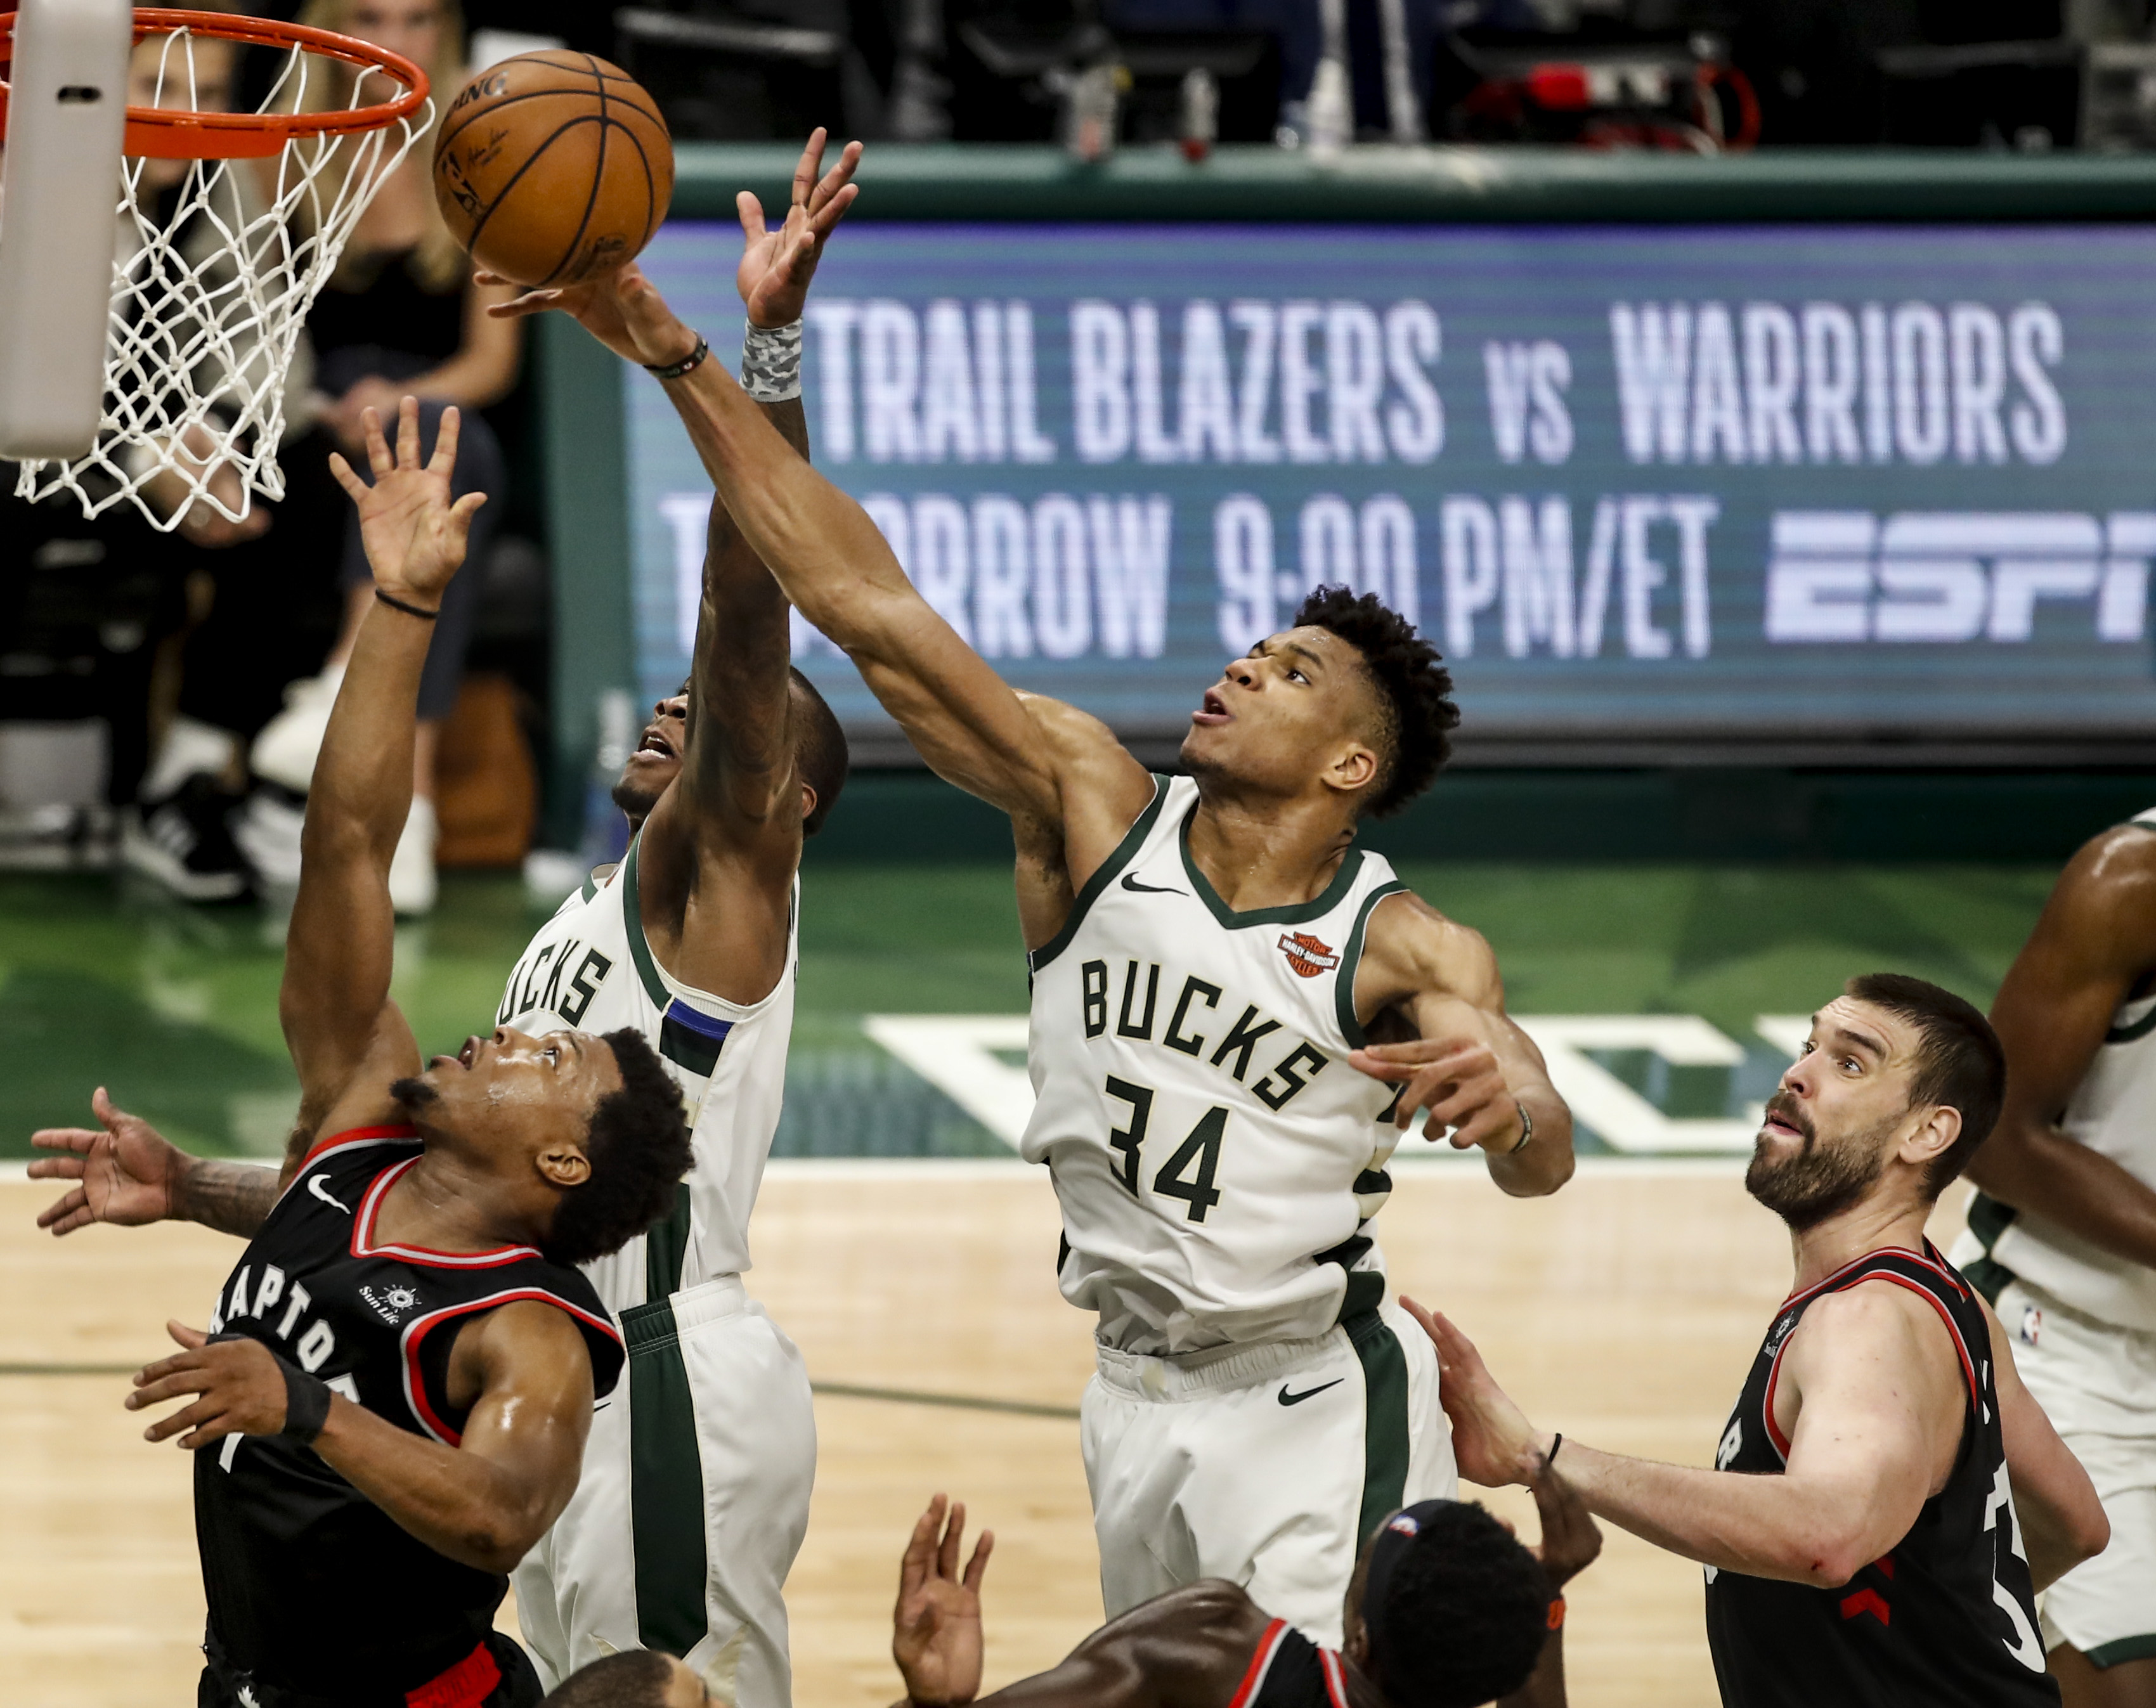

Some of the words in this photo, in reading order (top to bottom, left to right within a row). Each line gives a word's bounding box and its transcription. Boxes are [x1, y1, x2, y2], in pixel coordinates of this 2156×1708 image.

[805, 299, 1056, 463] TRAIL
[1070, 299, 1445, 463] BLAZERS
[1610, 301, 2067, 465] WARRIORS
[1440, 493, 1720, 659] PM/ET
[499, 938, 614, 1030] UCKS
[1282, 938, 1336, 967] HARLEY-DAVIDSON
[1296, 935, 1330, 955] MOTOR
[1082, 958, 1329, 1111] BUCKS
[1105, 1075, 1233, 1224] 34
[358, 1285, 381, 1309] Sun
[377, 1306, 399, 1325] Life
